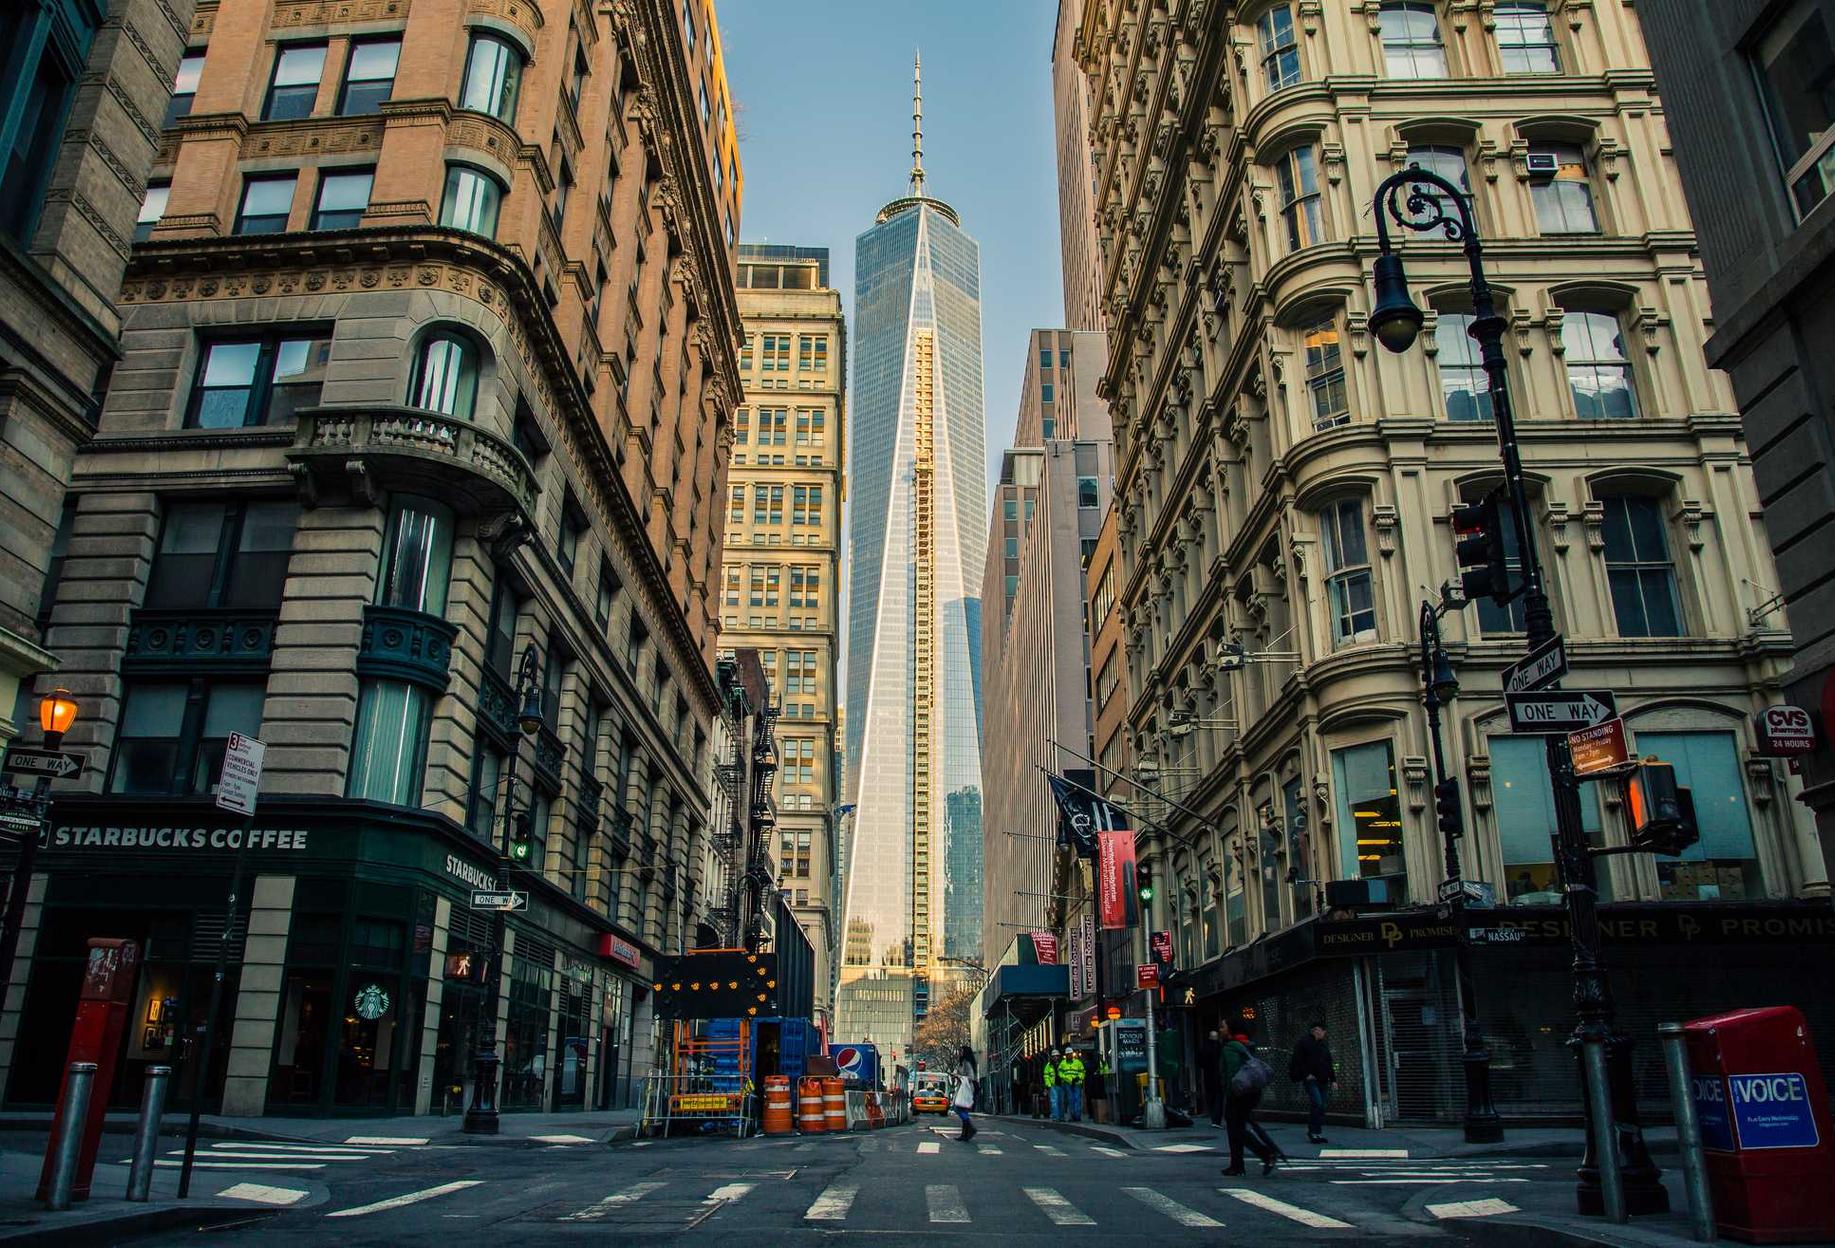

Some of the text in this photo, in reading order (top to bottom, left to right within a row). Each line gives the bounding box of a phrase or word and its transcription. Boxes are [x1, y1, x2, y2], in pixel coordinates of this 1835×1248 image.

[1511, 651, 1558, 691] ONE WAY
[1524, 704, 1600, 720] ONE WAY
[1767, 710, 1808, 726] CVS
[230, 734, 238, 749] 3
[1571, 725, 1614, 744] NO STANDING
[1772, 740, 1811, 748] 24 HOURS
[15, 756, 72, 771] ONE WAY
[55, 826, 309, 849] STARBUCKS COFFEE
[446, 854, 493, 892] STARBUCKS
[479, 896, 495, 904] ONE
[1323, 932, 1374, 944] DESIGNER
[1488, 932, 1521, 941] NASSAU
[1071, 928, 1079, 967] Roberts
[1084, 915, 1093, 992] Lucille Roberts
[1695, 1080, 1724, 1102] OICE
[1737, 1077, 1803, 1103] VOICE
